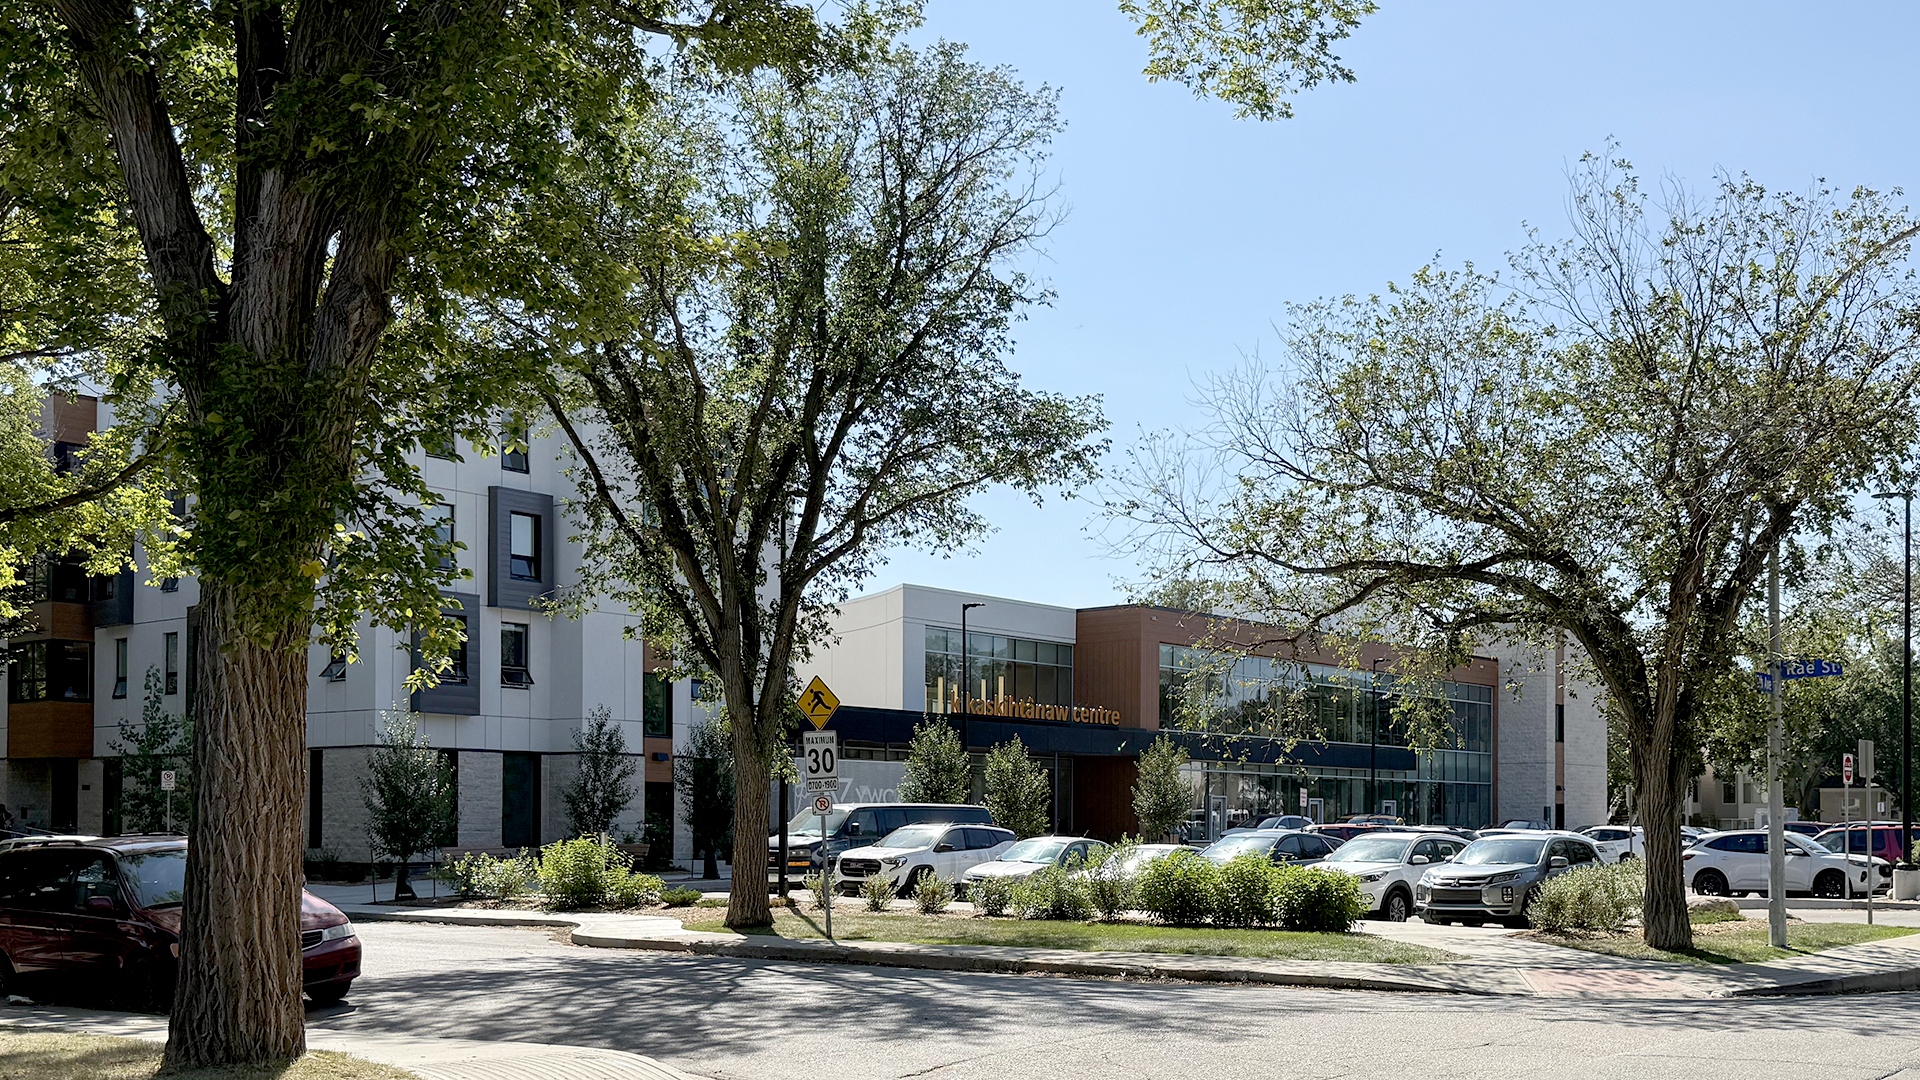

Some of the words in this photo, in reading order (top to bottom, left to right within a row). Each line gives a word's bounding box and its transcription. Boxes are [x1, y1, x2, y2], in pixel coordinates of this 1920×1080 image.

[1786, 661, 1815, 676] Rae
[1821, 660, 1838, 674] St
[1073, 705, 1121, 726] centre
[805, 735, 835, 745] MAXIMUM
[808, 748, 835, 774] 30
[808, 780, 837, 790] 0700-1900
[855, 786, 900, 803] YWC
